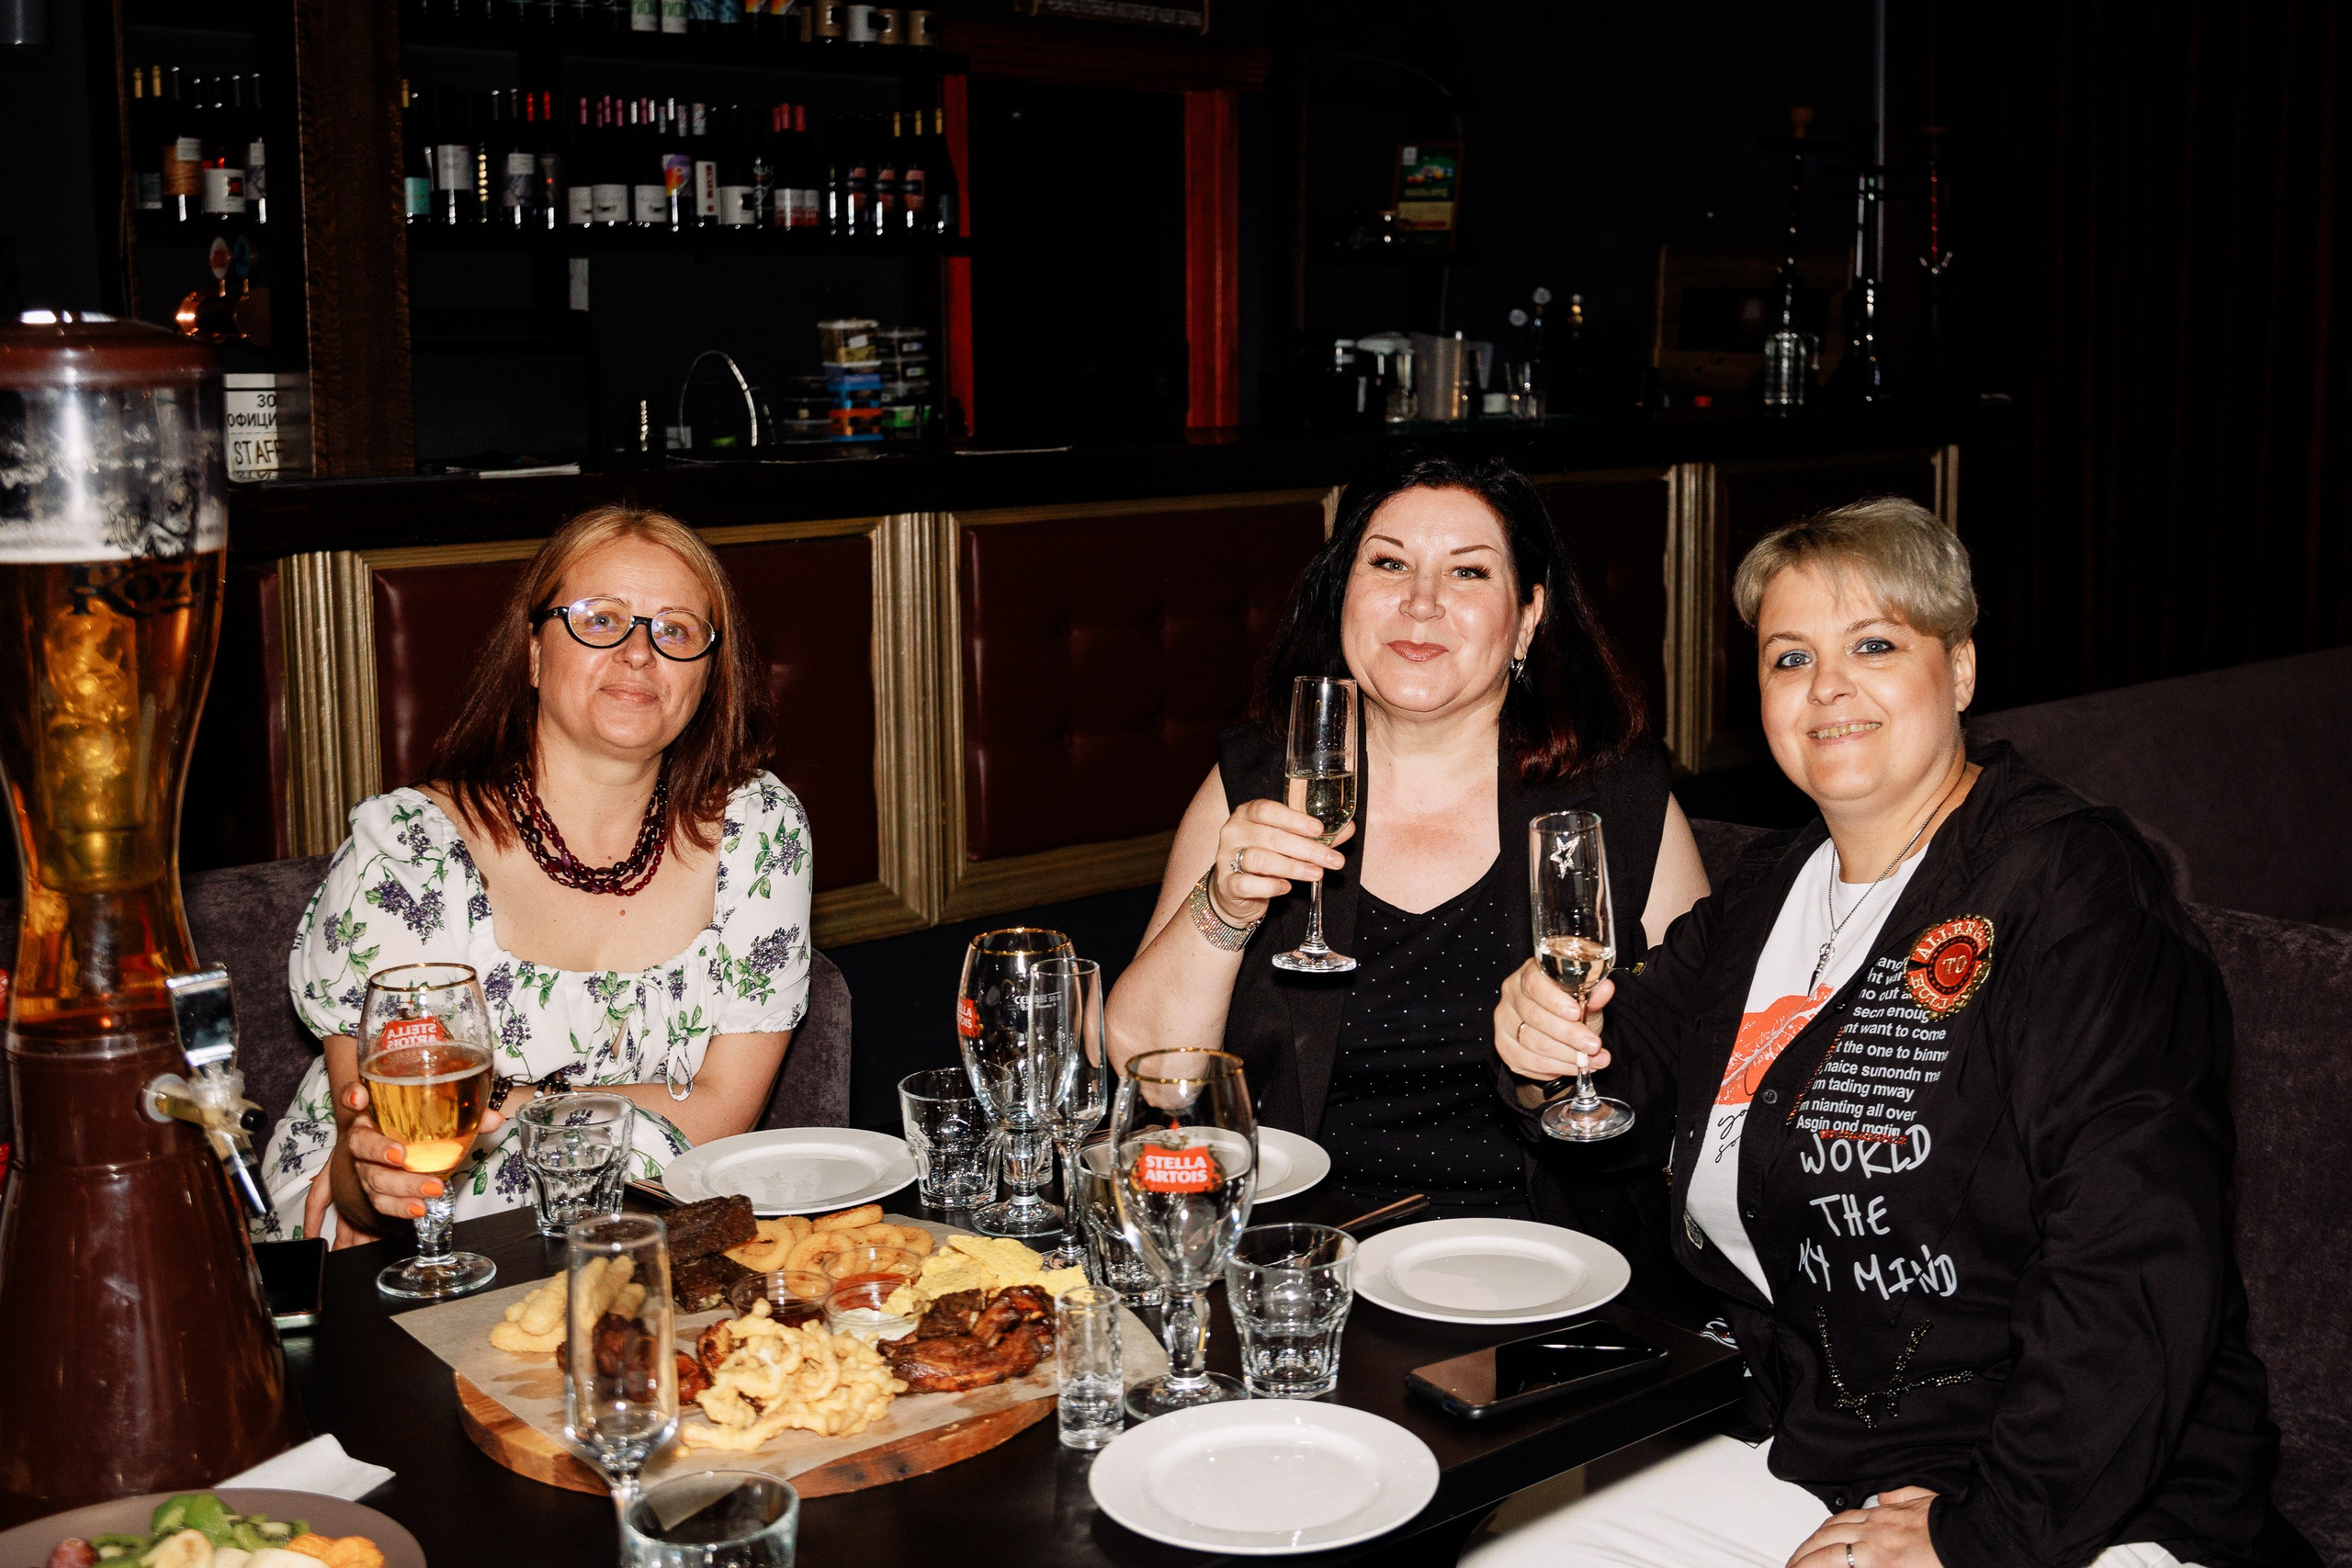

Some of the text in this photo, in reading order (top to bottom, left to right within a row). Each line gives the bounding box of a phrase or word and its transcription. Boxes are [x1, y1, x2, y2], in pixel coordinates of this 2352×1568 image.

[1941, 954, 1968, 975] TO
[1886, 1006, 1932, 1024] enoug
[1860, 1022, 1893, 1037] want
[1894, 1024, 1909, 1038] to
[1911, 1029, 1947, 1042] come
[1843, 1041, 1863, 1055] the
[1867, 1044, 1893, 1058] one
[1896, 1046, 1910, 1059] to
[1828, 1078, 1871, 1098] tading
[1872, 1084, 1915, 1103] mway
[1811, 1098, 1864, 1118] nianting
[1866, 1103, 1884, 1117] all
[1885, 1107, 1917, 1122] over
[1145, 1155, 1208, 1169] STELLA
[1145, 1168, 1208, 1184] ARTOIS
[1809, 1193, 1891, 1236] THE
[1853, 1244, 1958, 1301] MIND
